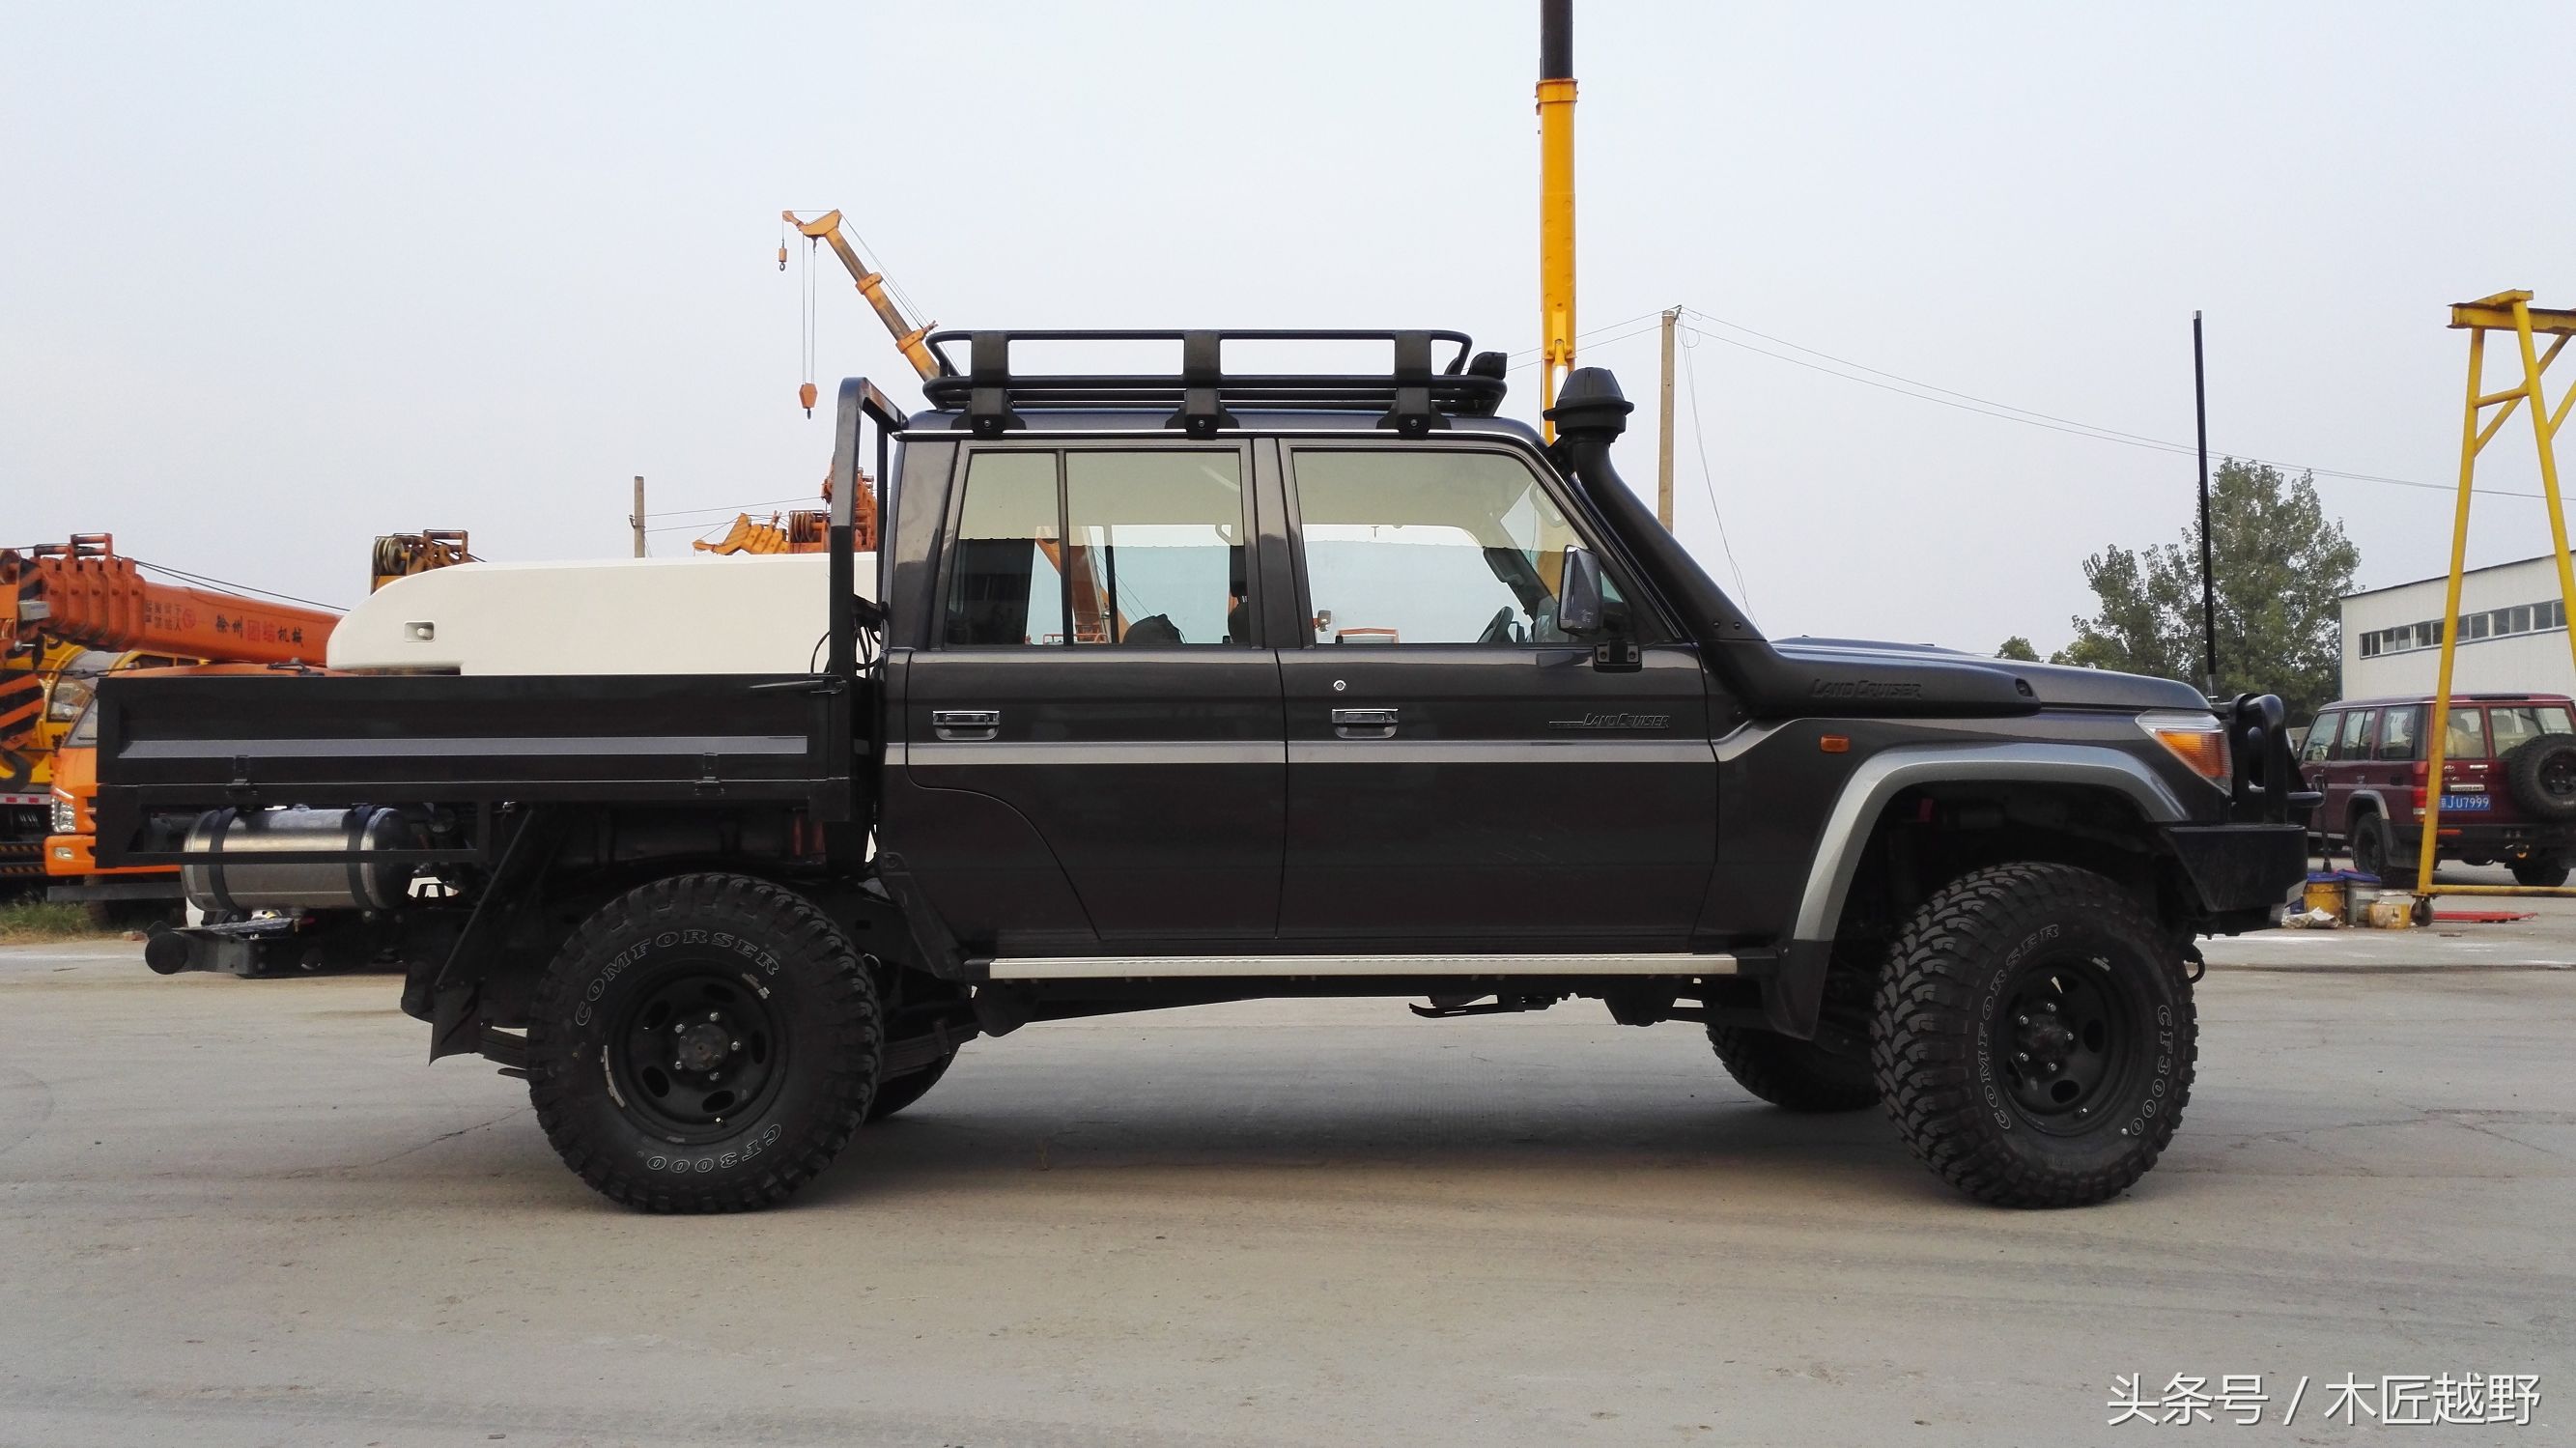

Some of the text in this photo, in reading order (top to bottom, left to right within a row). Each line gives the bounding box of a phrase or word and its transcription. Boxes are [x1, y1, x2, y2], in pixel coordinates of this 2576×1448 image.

[575, 928, 780, 1027] COMFORSER
[1977, 923, 2059, 1129] COMFORSER
[2130, 1005, 2173, 1136] CF3000
[646, 1123, 782, 1174] CF3000
